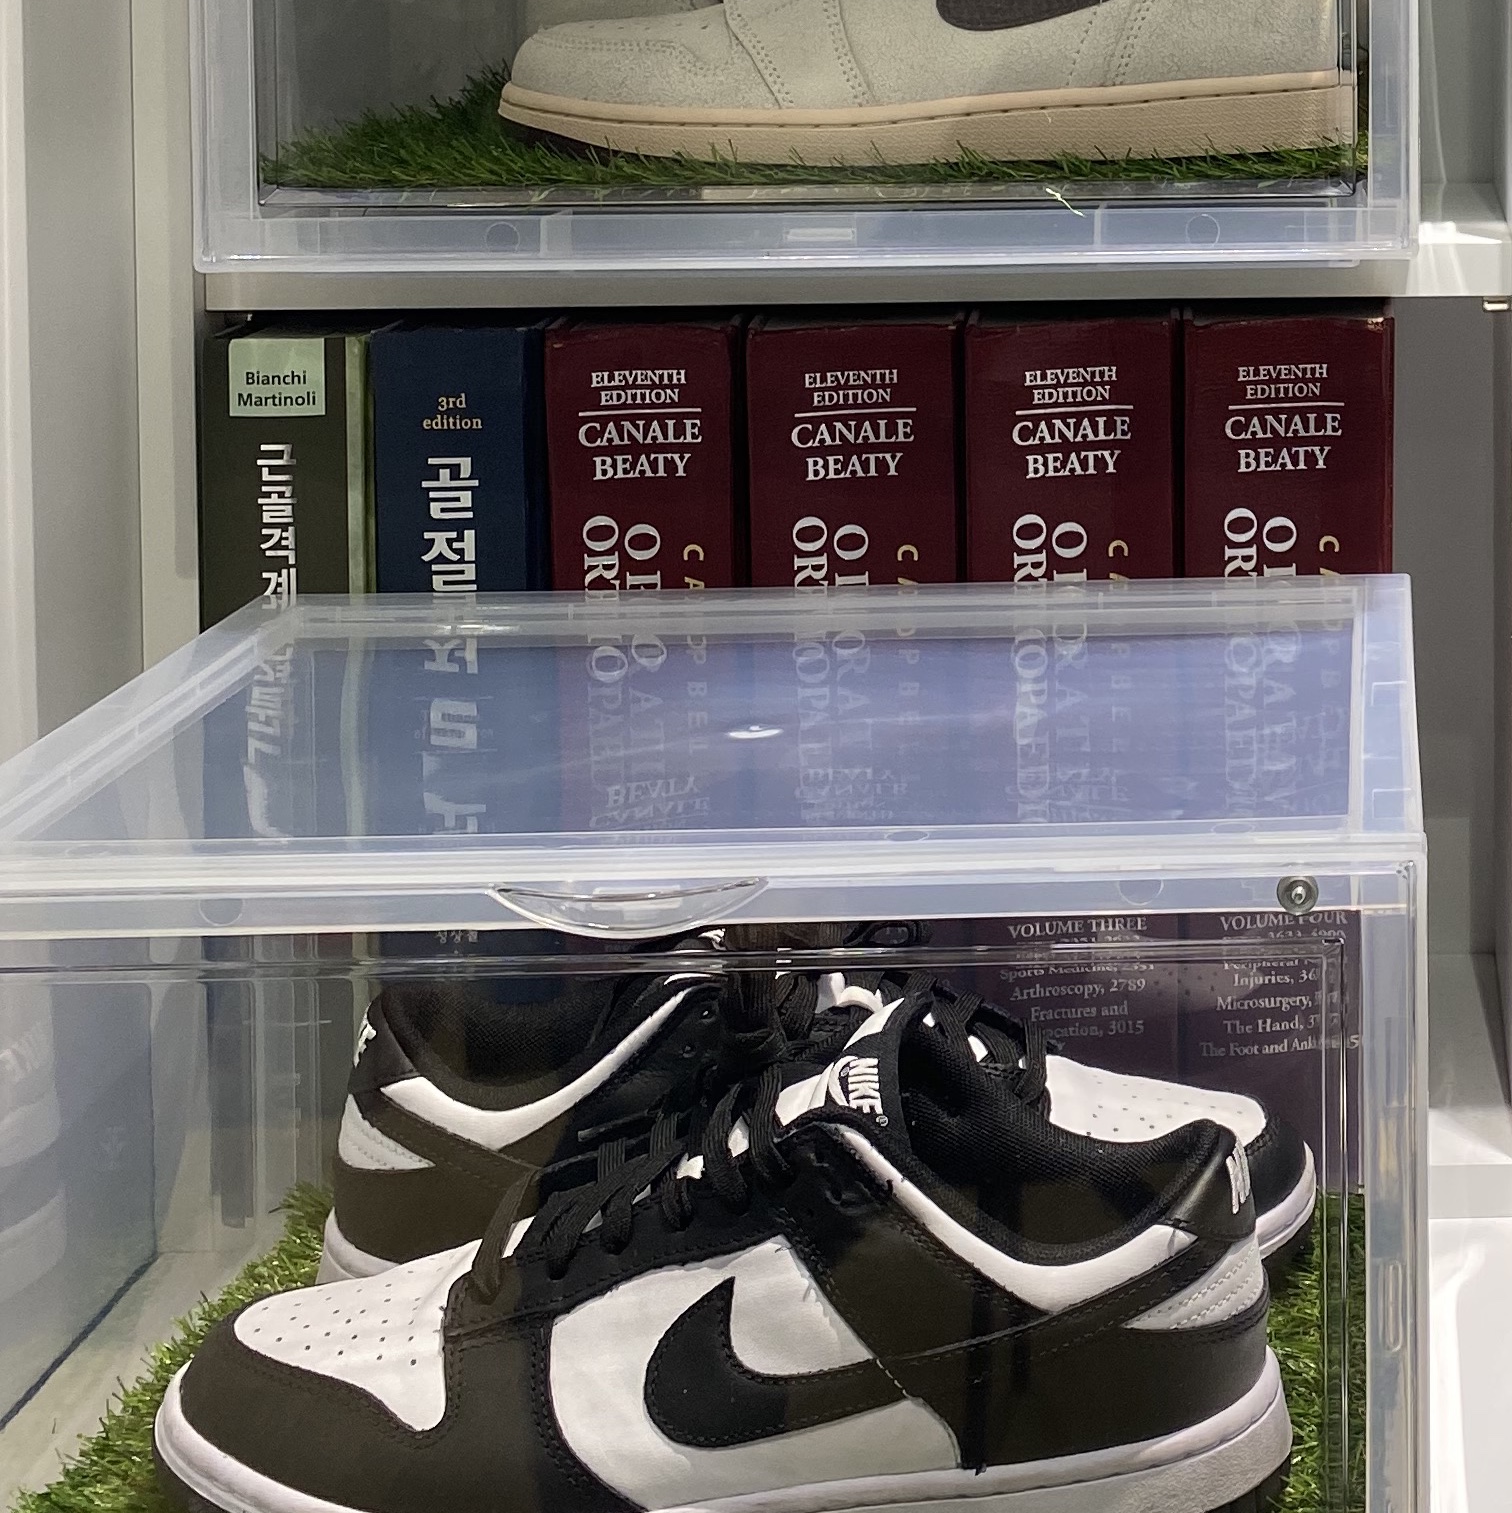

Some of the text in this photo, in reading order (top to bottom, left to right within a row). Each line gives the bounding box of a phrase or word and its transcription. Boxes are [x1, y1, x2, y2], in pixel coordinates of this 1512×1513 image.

[245, 370, 307, 387] Bianchi
[591, 369, 687, 388] ELEVENTH
[804, 369, 898, 388] ELEVENTH
[1024, 366, 1117, 386] ELEVENTH
[1237, 364, 1328, 381] ELEVENTH
[237, 390, 317, 408] Martinoli
[600, 388, 680, 405] EDITION
[813, 388, 891, 406] EDITION
[1032, 385, 1110, 405] EDITION
[1245, 382, 1321, 399] EDITION
[438, 393, 467, 410] 3rd
[422, 414, 483, 430] edition
[1012, 416, 1131, 446] CANALE
[1225, 412, 1342, 439] CANALE
[578, 419, 702, 447] CANALE
[791, 418, 914, 448] CANALE
[593, 453, 691, 481] BEATY
[806, 452, 903, 481] BEATY
[1026, 450, 1120, 478] BEATY
[1237, 446, 1331, 473] BEATY
[1008, 917, 1147, 938] VOLUME THREE
[1220, 914, 1295, 931] VOLUME
[1010, 978, 1146, 1001] Arthroscopy, 2789
[1031, 1000, 1129, 1022] Fractures and
[1216, 995, 1312, 1011] Microsurgery,
[1108, 1020, 1144, 1035] 3015
[1223, 1020, 1253, 1034] The
[1257, 1015, 1304, 1033] Hand,
[848, 1057, 884, 1114] NIKE
